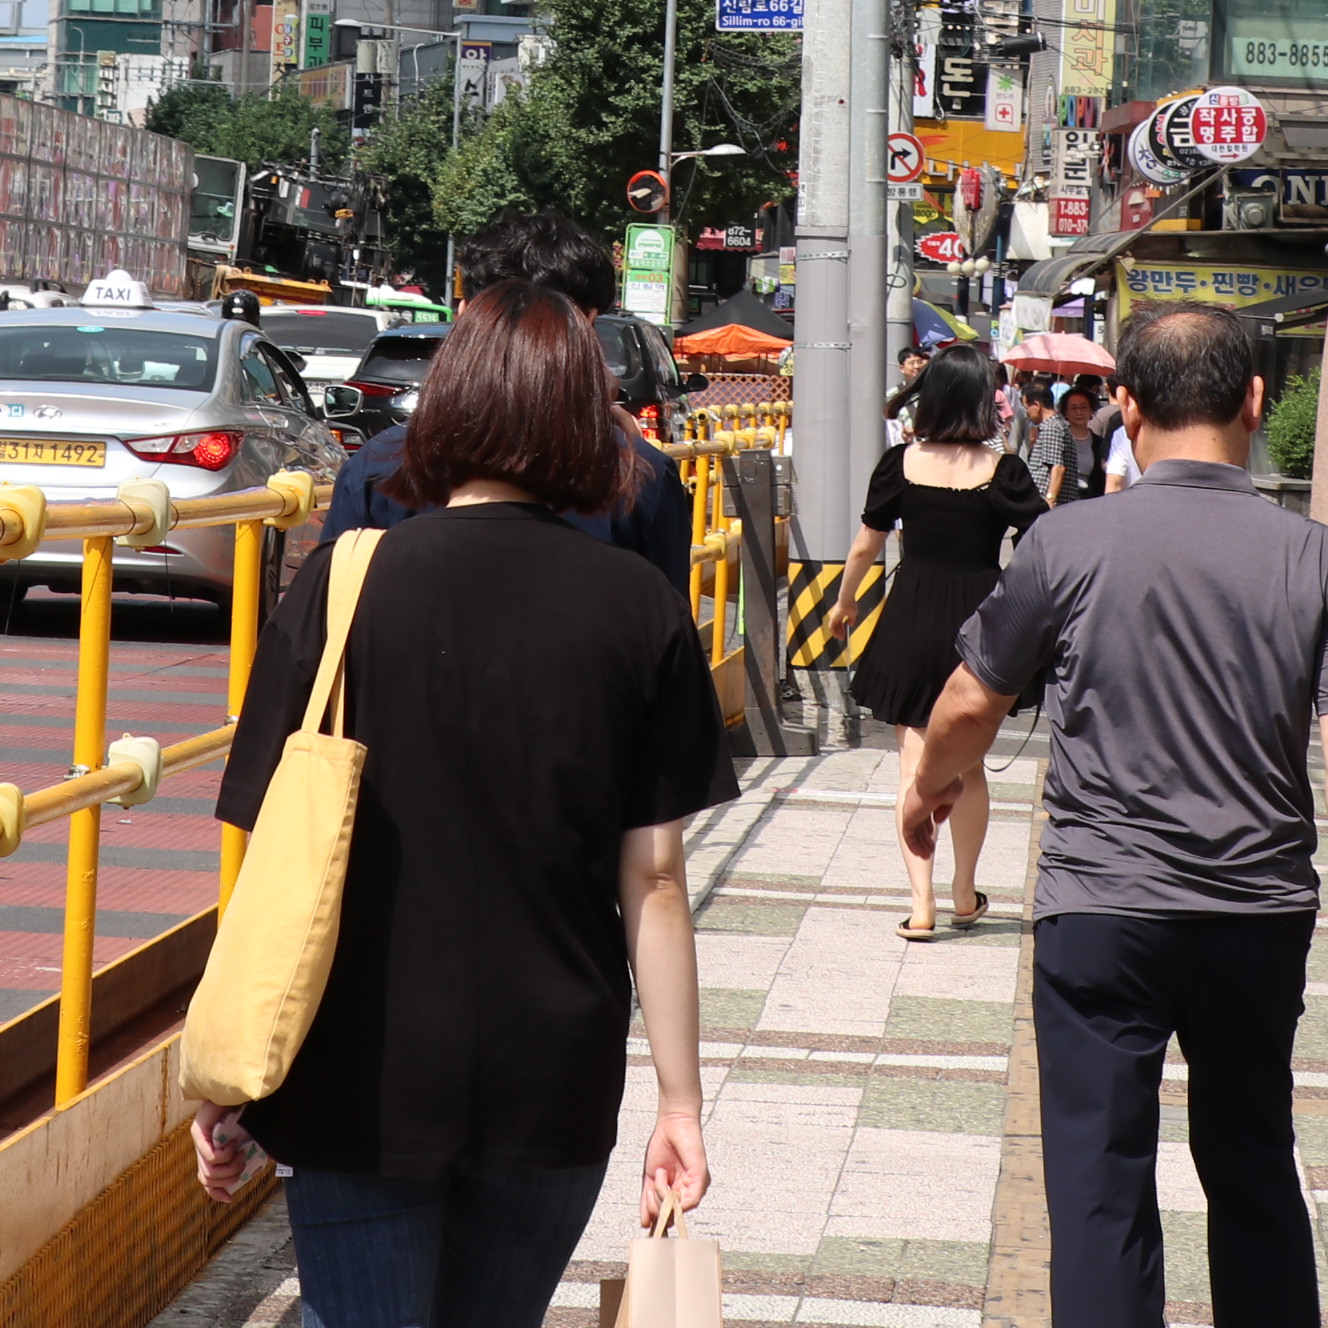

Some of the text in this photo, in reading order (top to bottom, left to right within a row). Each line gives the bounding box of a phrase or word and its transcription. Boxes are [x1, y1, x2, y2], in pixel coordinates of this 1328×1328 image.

[722, 14, 771, 28] Sillim-ro
[727, 236, 752, 247] 6604
[94, 285, 132, 302] TAXI
[49, 443, 99, 465] 1492
